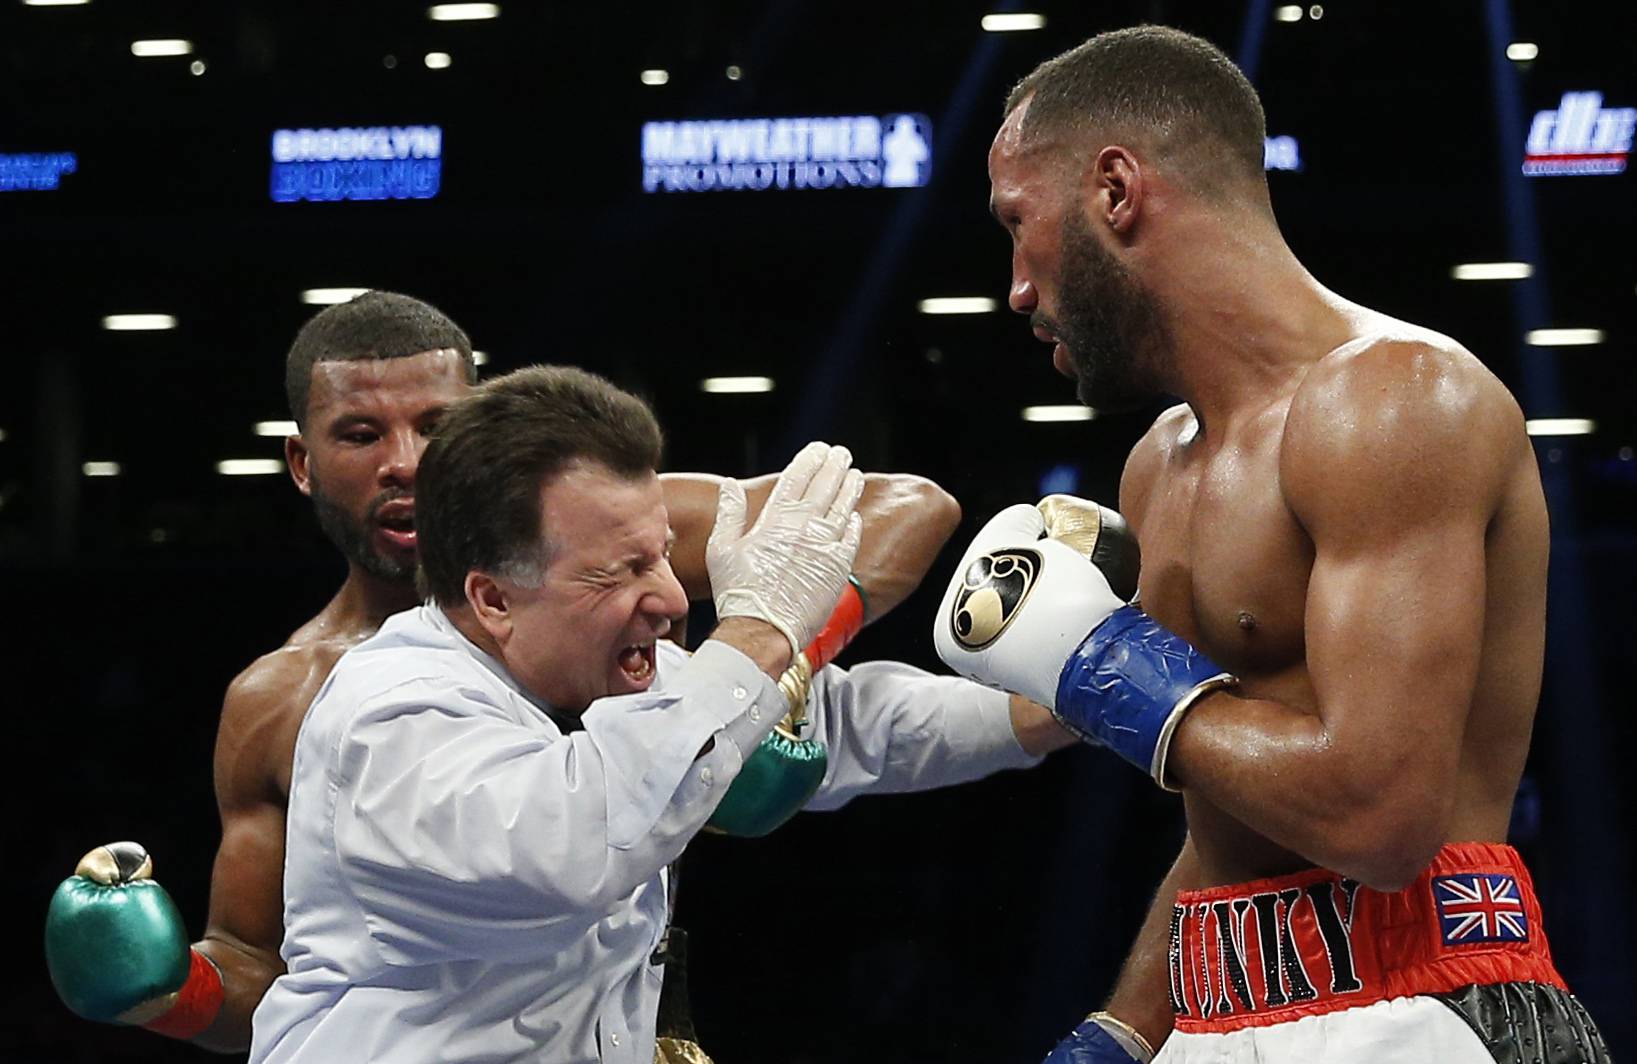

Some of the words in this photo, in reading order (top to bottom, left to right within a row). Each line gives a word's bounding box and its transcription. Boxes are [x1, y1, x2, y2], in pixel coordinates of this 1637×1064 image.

[272, 126, 441, 162] BROOKLYN
[643, 116, 880, 163] MAYWEATHER
[271, 160, 441, 201] BOXING
[643, 162, 882, 192] PROMOTIONS
